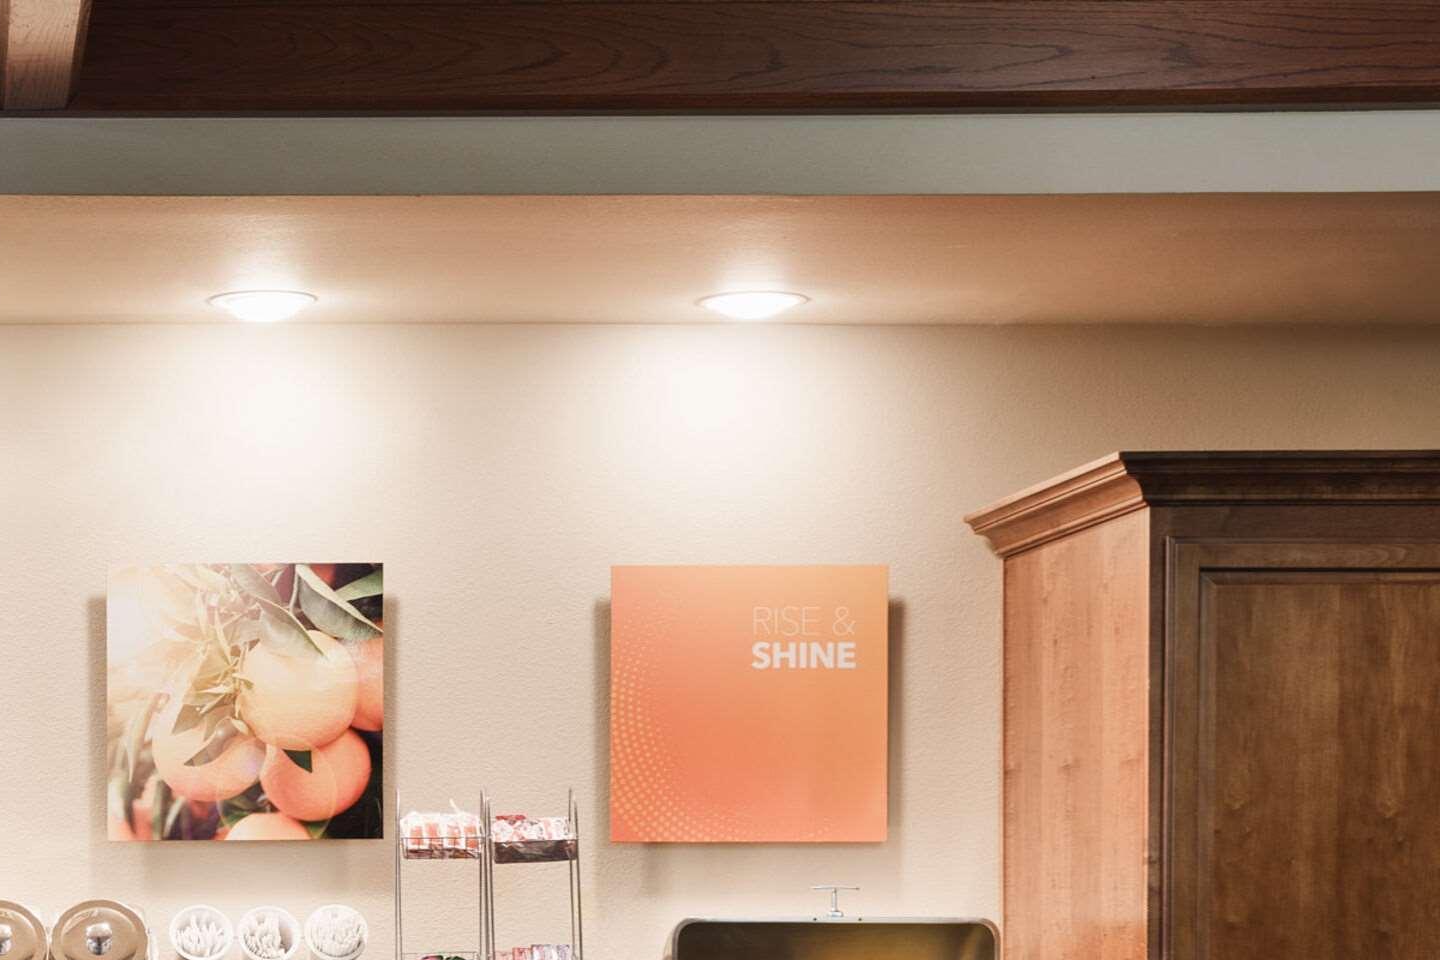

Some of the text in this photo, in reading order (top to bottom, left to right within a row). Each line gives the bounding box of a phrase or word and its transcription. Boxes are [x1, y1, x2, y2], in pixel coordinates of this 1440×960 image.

[752, 606, 856, 636] RISE &
[751, 641, 856, 669] SHINE
